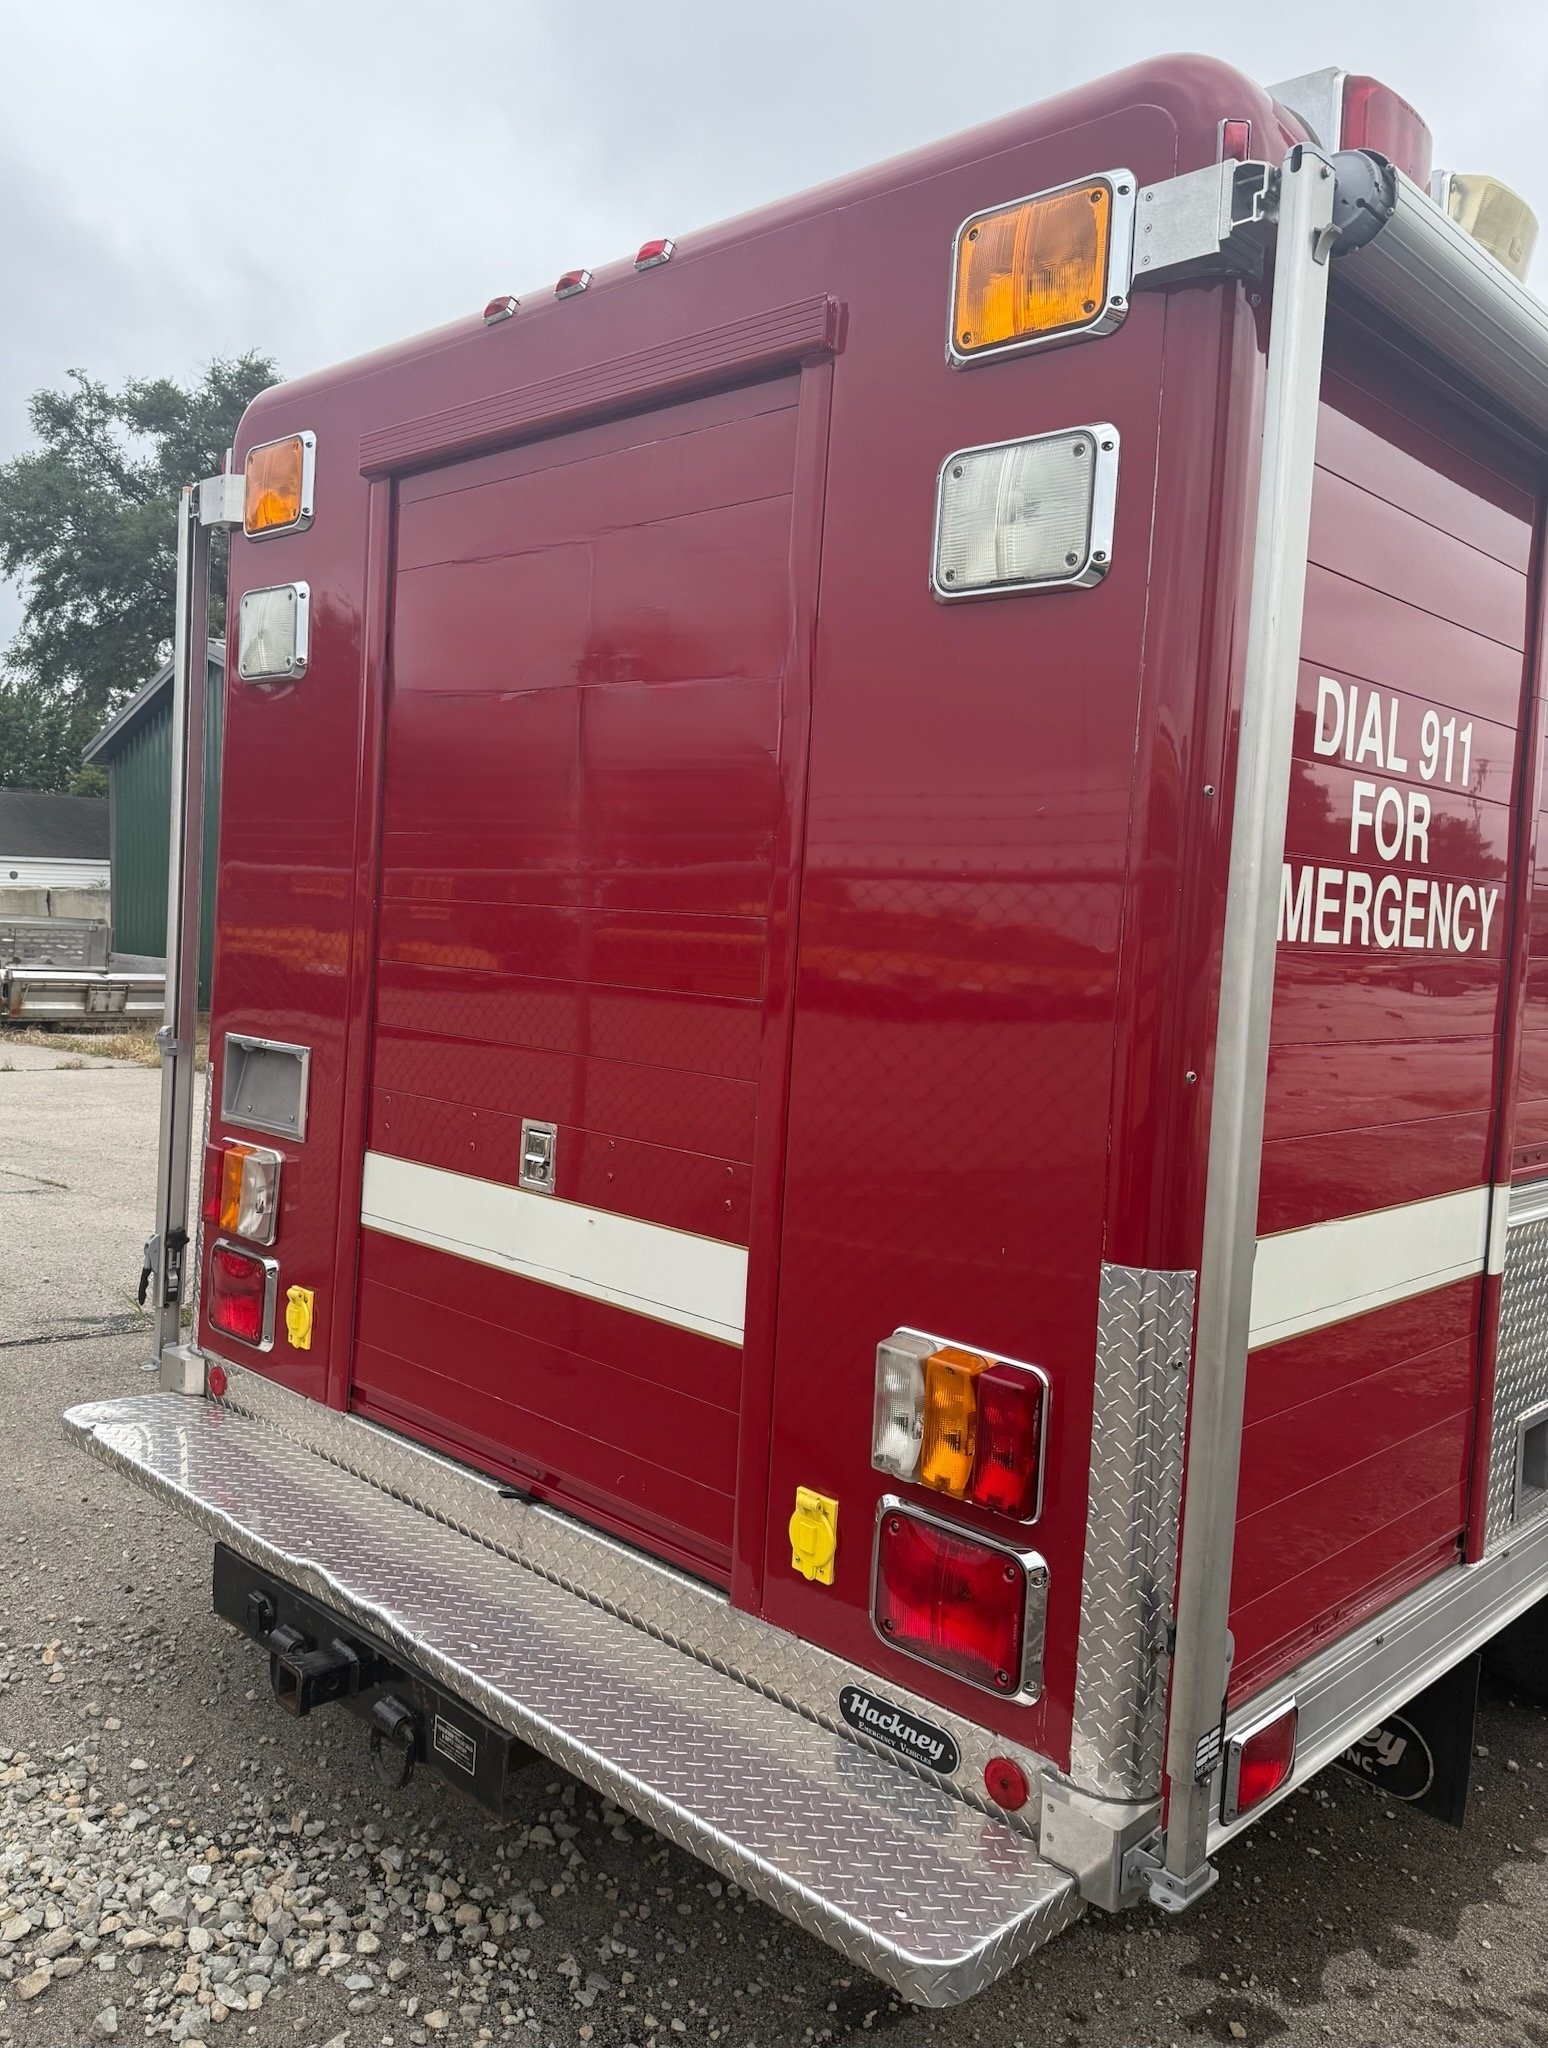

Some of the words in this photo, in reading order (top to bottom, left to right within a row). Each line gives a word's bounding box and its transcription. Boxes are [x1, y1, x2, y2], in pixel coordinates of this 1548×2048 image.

[1313, 676, 1408, 773] DIAL
[1419, 710, 1473, 786] 911
[1350, 780, 1431, 863] FOR
[1277, 863, 1498, 952] MERGENCY
[850, 1693, 944, 1760] Hackney
[858, 1721, 896, 1747] EMERGENCY
[900, 1743, 932, 1765] VEHICLES
